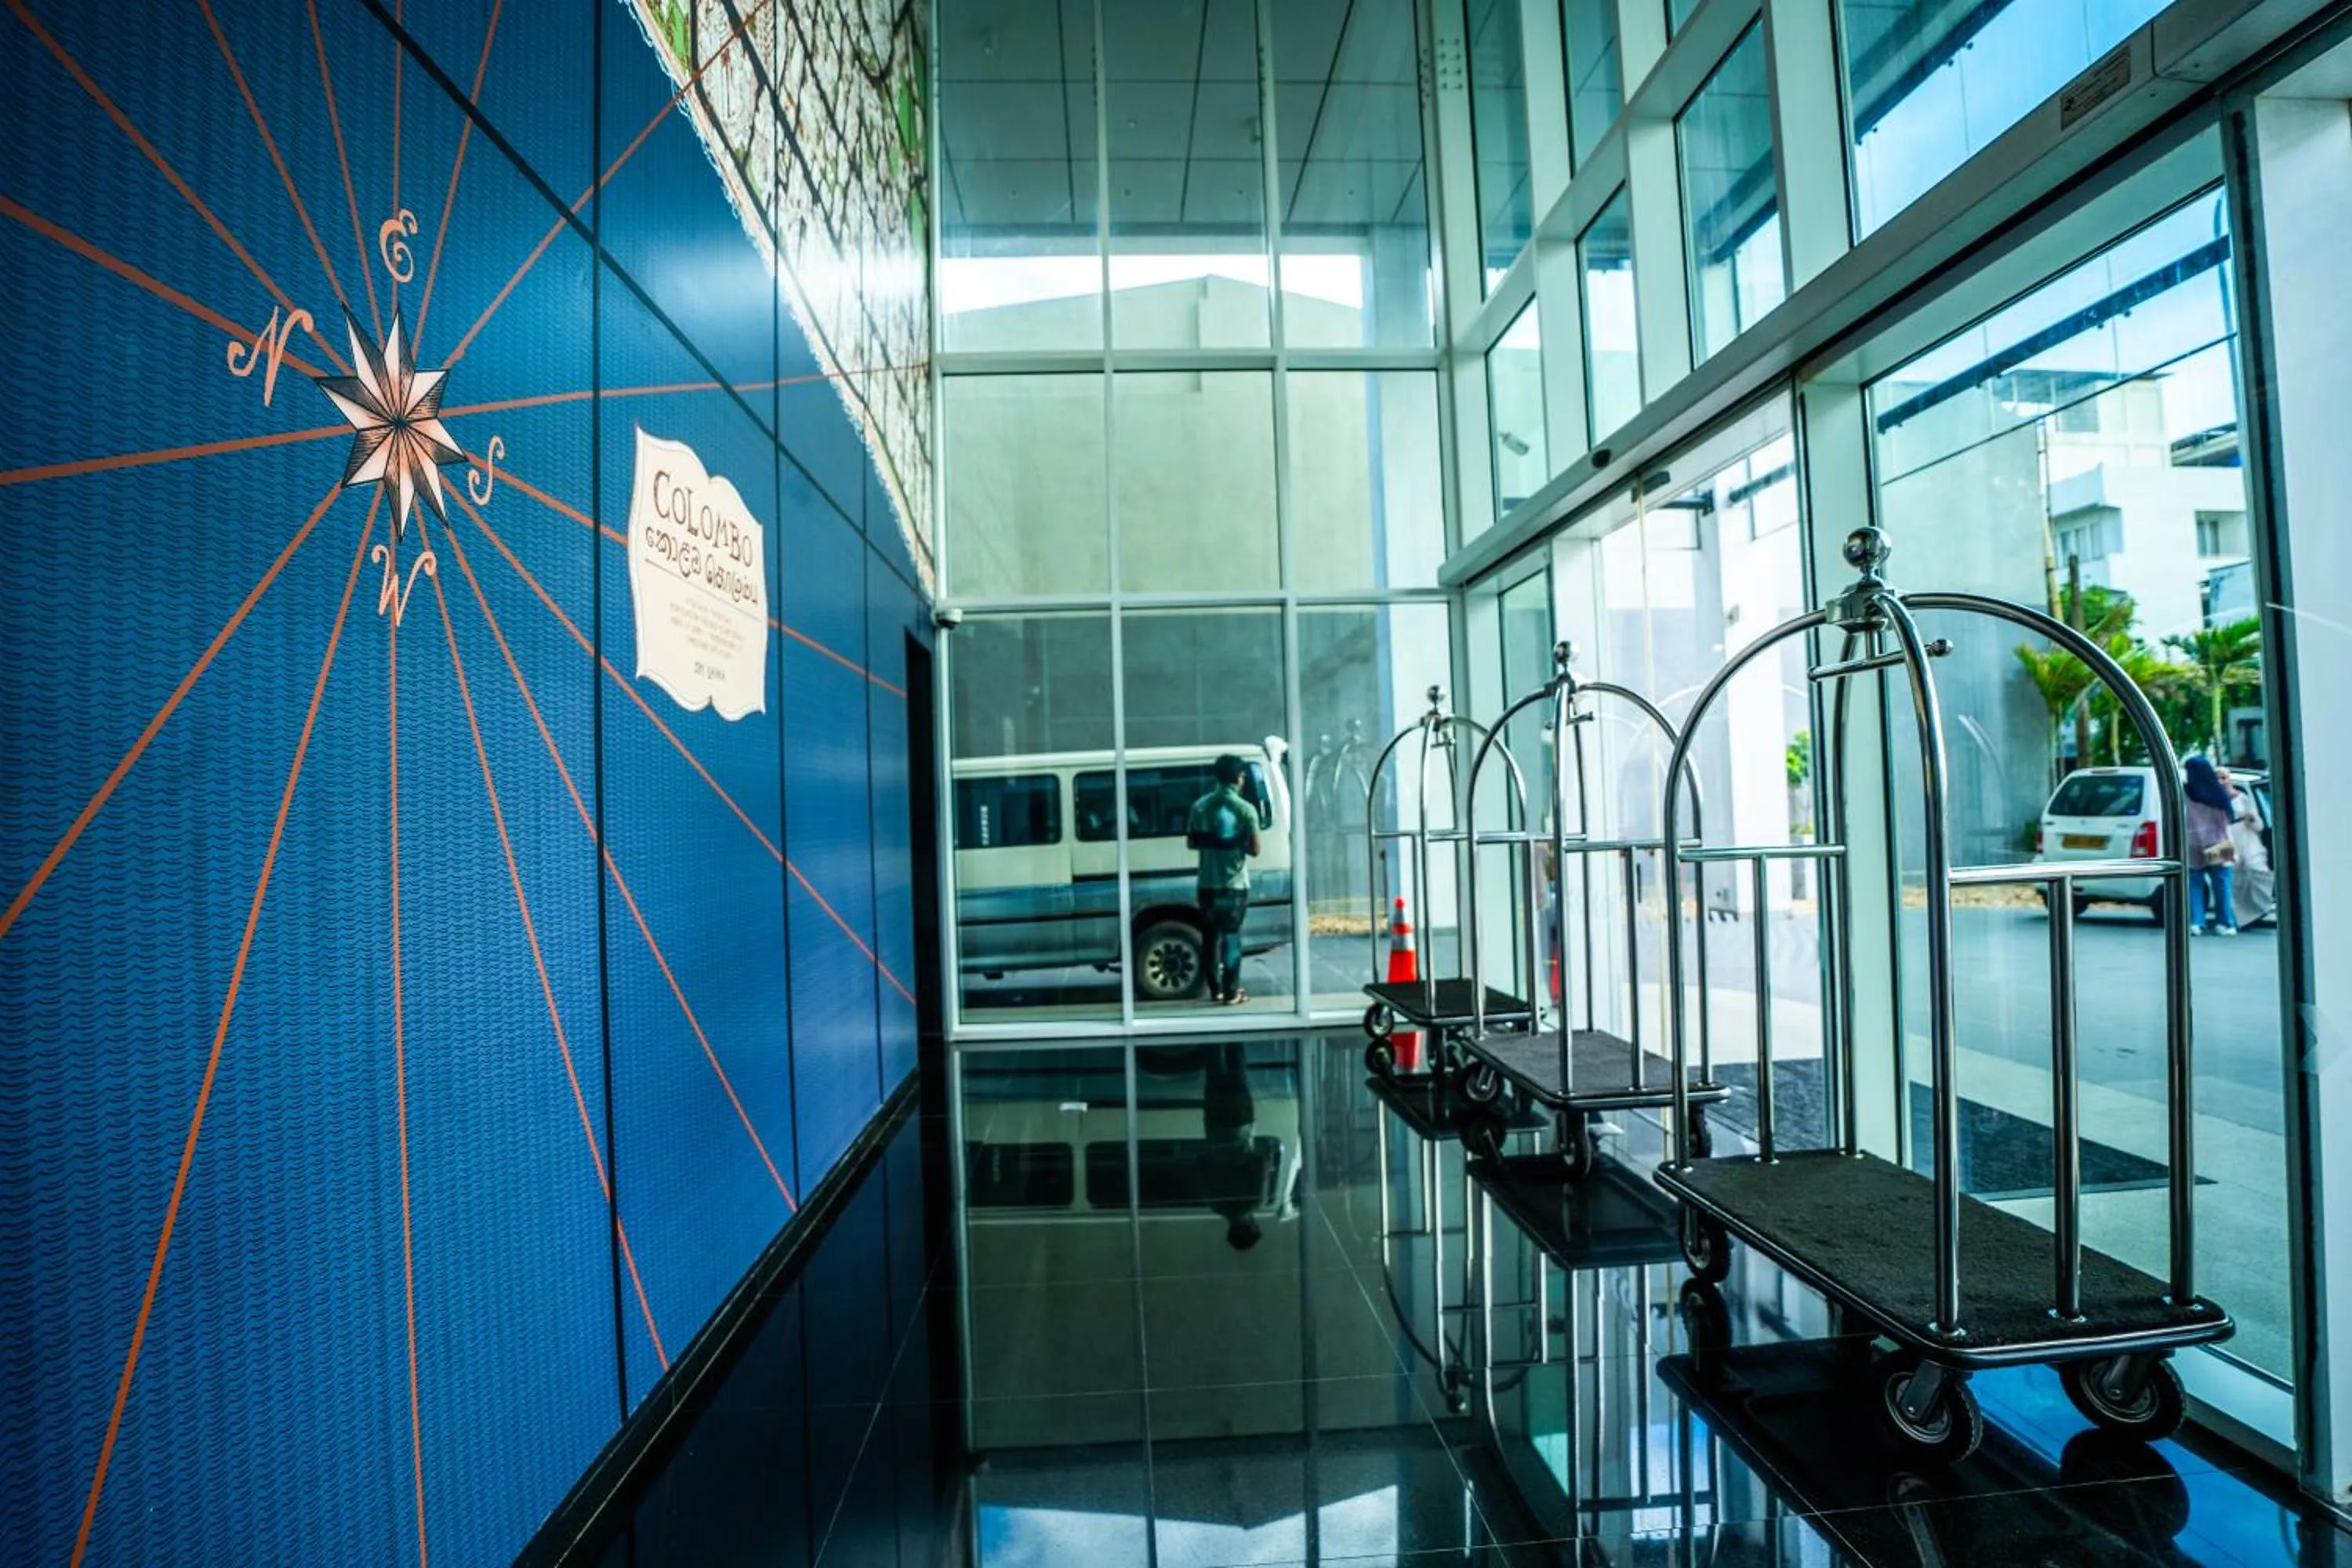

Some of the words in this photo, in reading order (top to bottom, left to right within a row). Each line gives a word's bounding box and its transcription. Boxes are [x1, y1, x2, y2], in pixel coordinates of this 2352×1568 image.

[227, 305, 314, 408] N
[467, 435, 506, 506] S
[653, 470, 753, 567] COLOMBO
[372, 545, 437, 627] W
